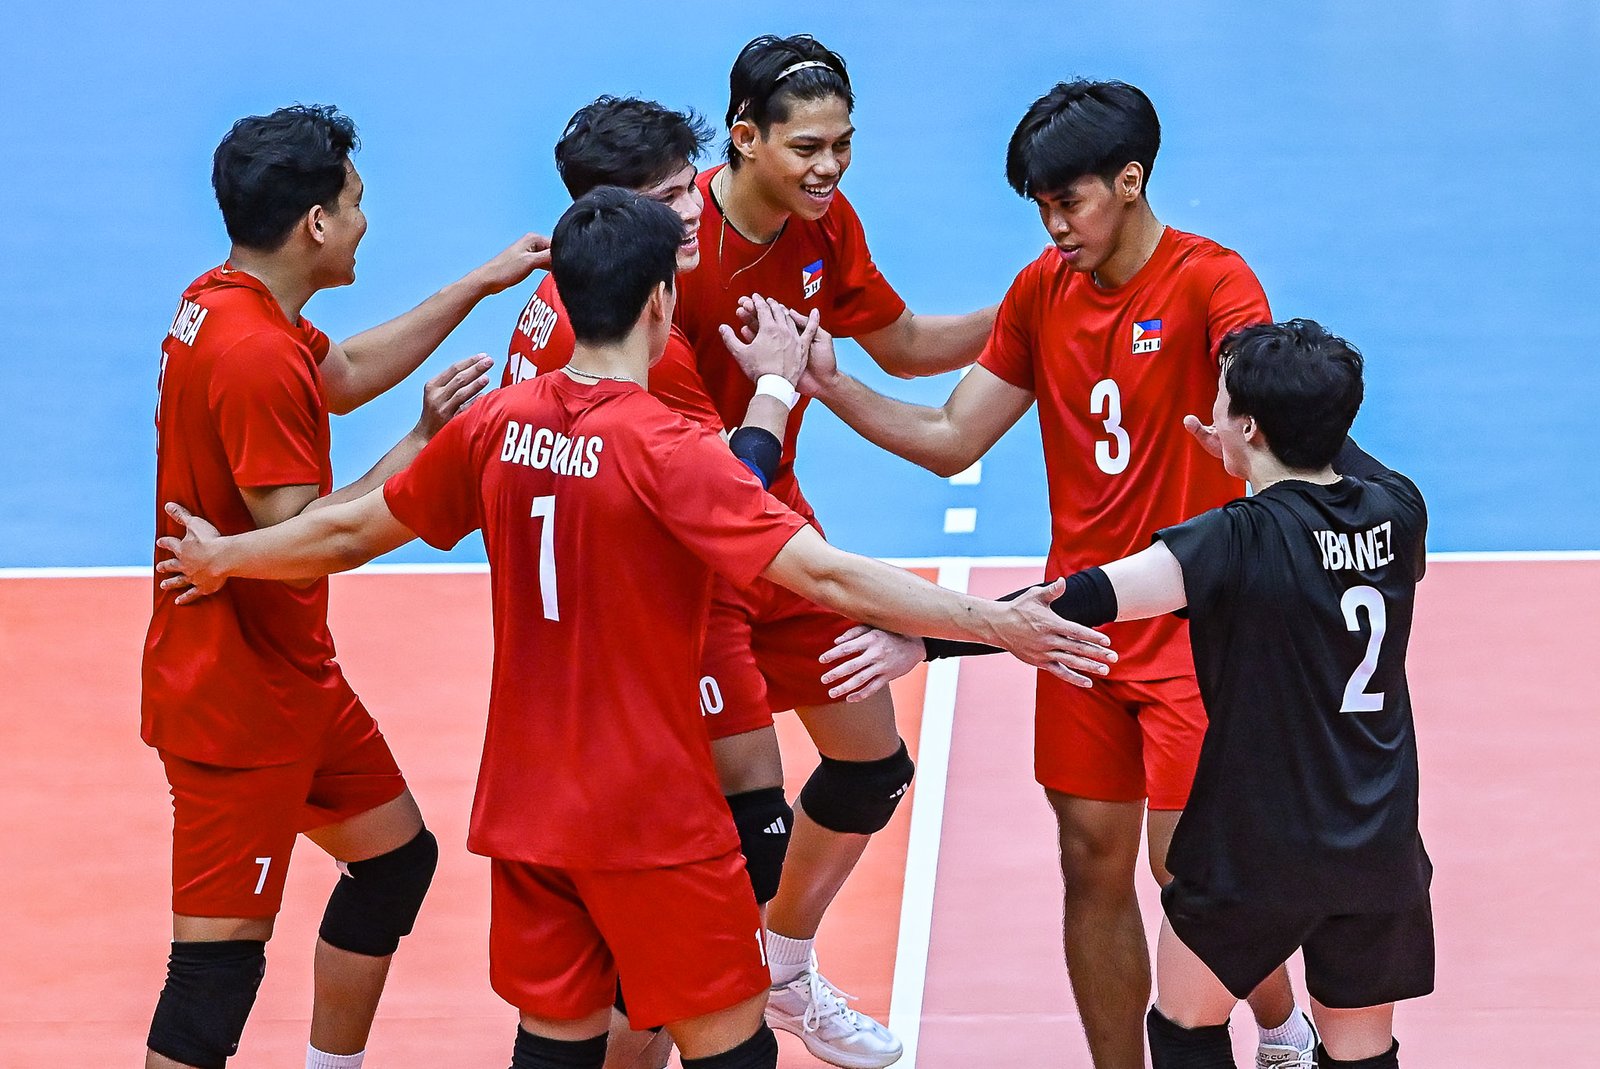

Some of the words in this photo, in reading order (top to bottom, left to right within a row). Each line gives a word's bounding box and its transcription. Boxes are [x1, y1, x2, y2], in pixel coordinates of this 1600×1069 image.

[518, 293, 559, 352] ESPEJO
[1133, 340, 1160, 353] PHI
[1090, 378, 1131, 475] 3
[530, 495, 560, 622] 1
[1339, 585, 1387, 713] 2
[254, 857, 272, 895] 7
